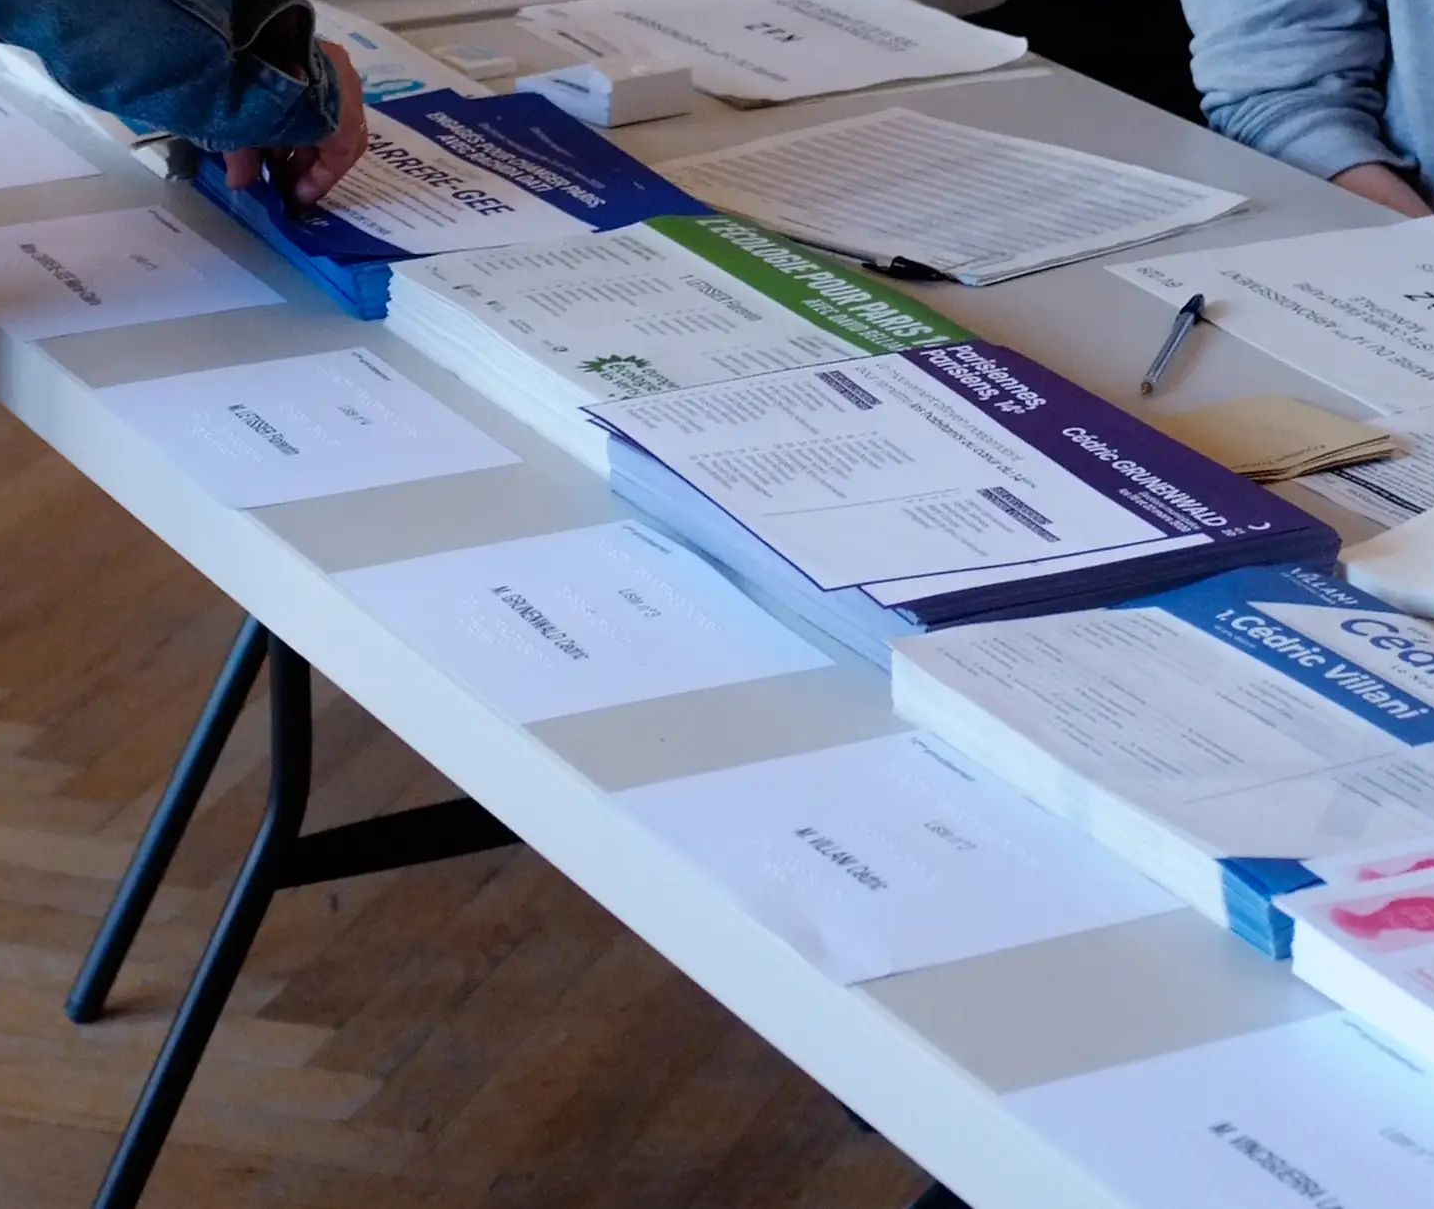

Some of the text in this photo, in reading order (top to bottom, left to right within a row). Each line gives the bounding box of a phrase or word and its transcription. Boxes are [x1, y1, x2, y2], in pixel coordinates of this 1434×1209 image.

[793, 271, 874, 304] POUR
[855, 302, 933, 337] PARIS
[908, 335, 955, 347] 1
[919, 348, 1002, 402] Parisiens,
[946, 345, 1047, 409] Parisiennes,
[1060, 426, 1120, 461] Cédric
[1111, 459, 1229, 528] GRUNENWALD
[1228, 615, 1331, 667] Cédric
[1323, 663, 1432, 718] Villani
